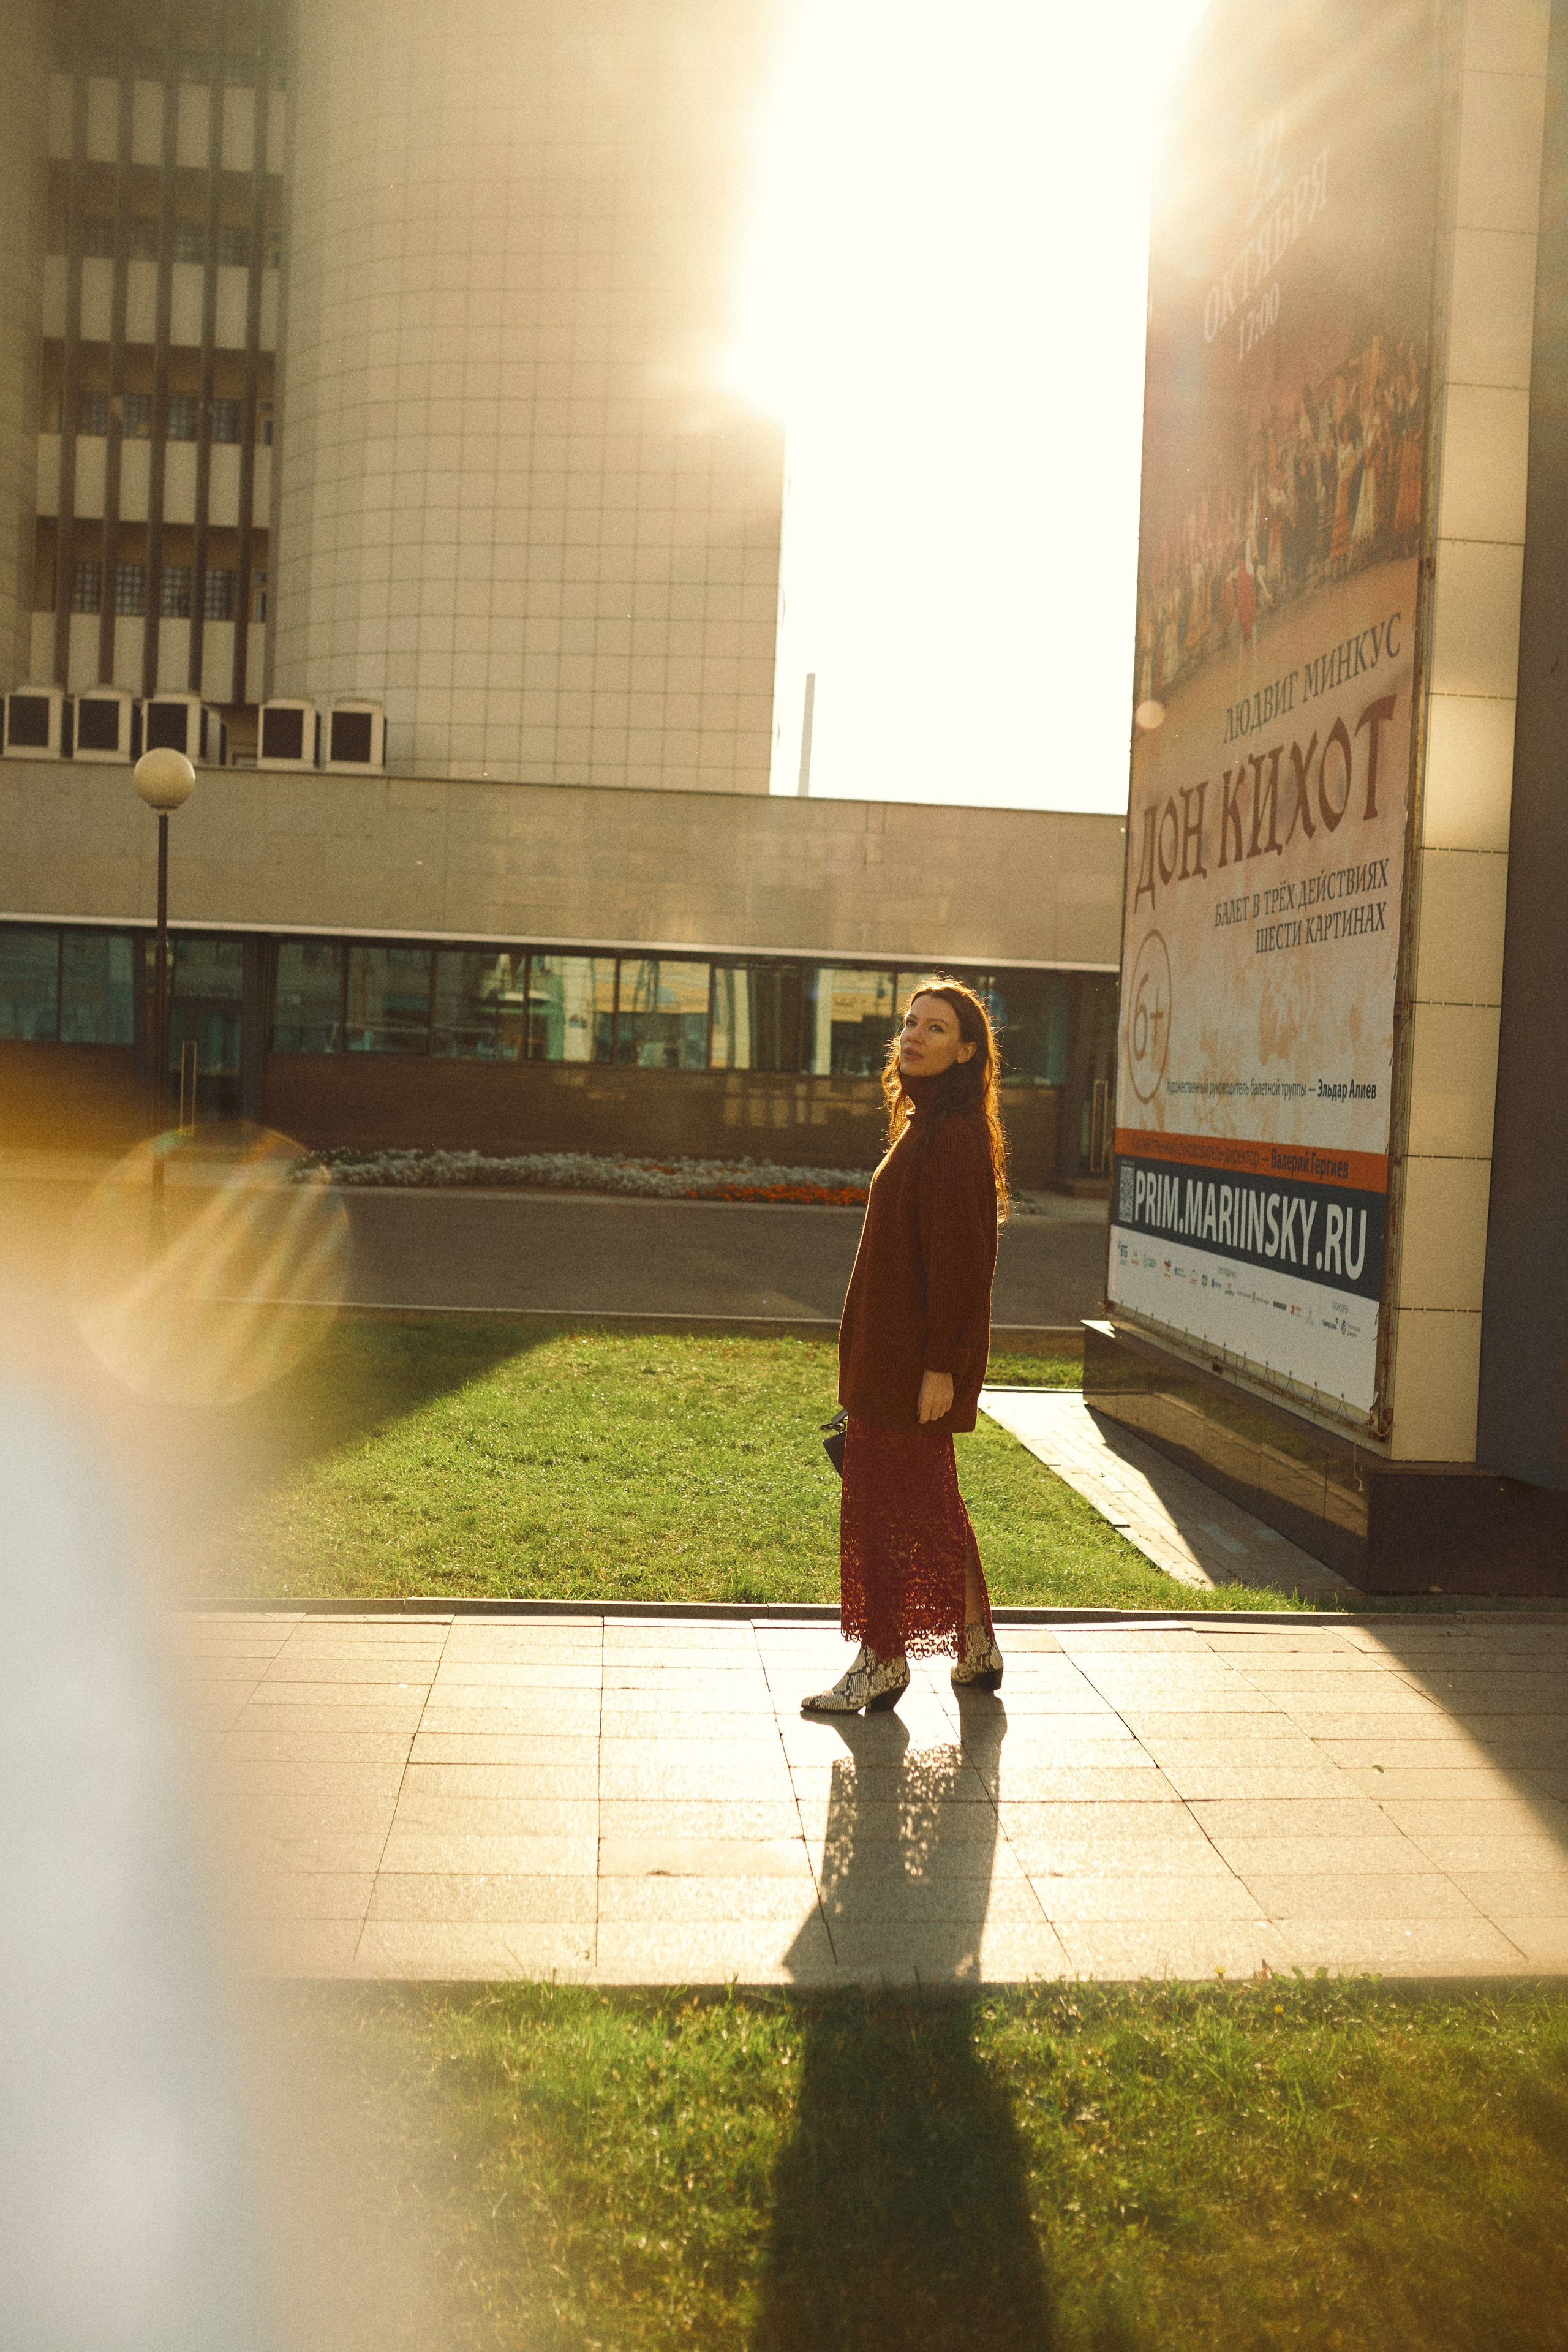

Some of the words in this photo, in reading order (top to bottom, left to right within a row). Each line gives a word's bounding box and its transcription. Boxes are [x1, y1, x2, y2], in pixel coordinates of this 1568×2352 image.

[1205, 143, 1327, 344] ОКТЯБРЯ
[1223, 671, 1298, 744] ЛЮДВИГ
[1302, 612, 1402, 703] МИНКУС
[1134, 781, 1208, 914] ДОН
[1218, 693, 1398, 869] КИХОТ
[1215, 892, 1250, 927] БАЛЕТ
[1253, 894, 1261, 920] В
[1264, 881, 1296, 914] ТРЁХ
[1298, 858, 1389, 912] ДЕЙСТВИЯХ
[1256, 922, 1302, 954] ШЕСТИ
[1306, 902, 1387, 946] КАРТИНАХ
[1134, 973, 1164, 1061] 6+
[1250, 1077, 1280, 1096] балетной
[1281, 1082, 1306, 1101] труппы
[1317, 1078, 1348, 1103] Эльдар
[1349, 1078, 1377, 1099] Алиев
[1272, 1148, 1310, 1177] Валерий
[1311, 1152, 1349, 1181] Гергиев
[1134, 1170, 1367, 1281] PRIM.MARIINSKY.RU
